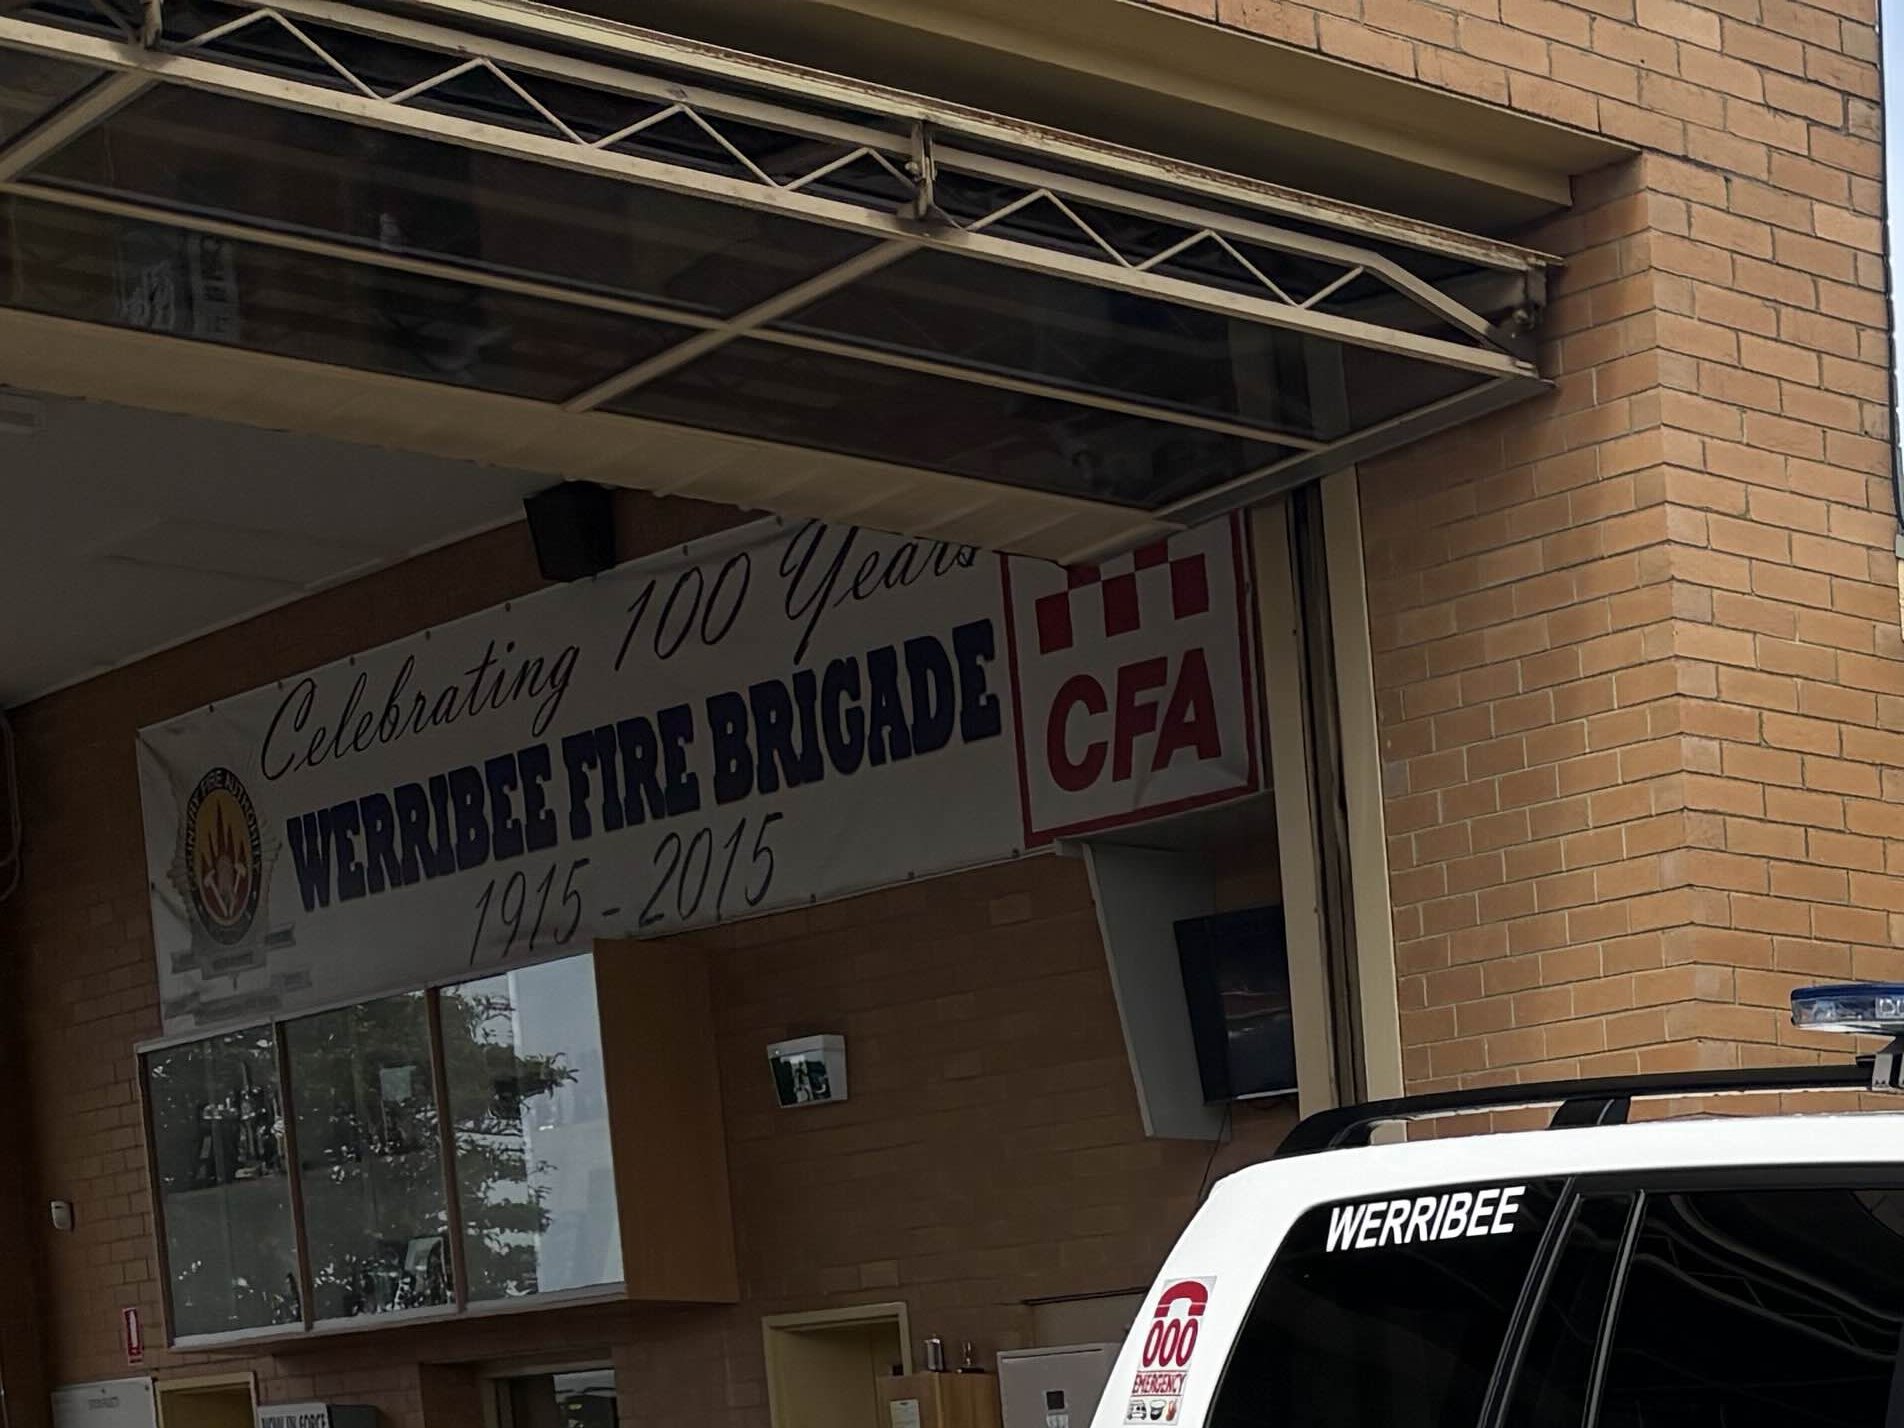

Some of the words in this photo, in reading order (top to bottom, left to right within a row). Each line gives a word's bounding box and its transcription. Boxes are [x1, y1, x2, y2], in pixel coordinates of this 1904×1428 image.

[260, 638, 581, 782] Celebrating
[613, 552, 752, 672] 100
[779, 517, 977, 666] Years
[1045, 646, 1223, 794] CFA
[285, 741, 559, 915] WERRIBEE
[560, 703, 702, 843] FIRE
[704, 616, 1004, 806] BRIGADE
[468, 857, 593, 967] 1915
[637, 810, 784, 931] 2015
[1325, 1185, 1527, 1253] WERRIBEE
[1131, 1373, 1188, 1395] EMERGENCY
[1142, 1318, 1199, 1368] 000
